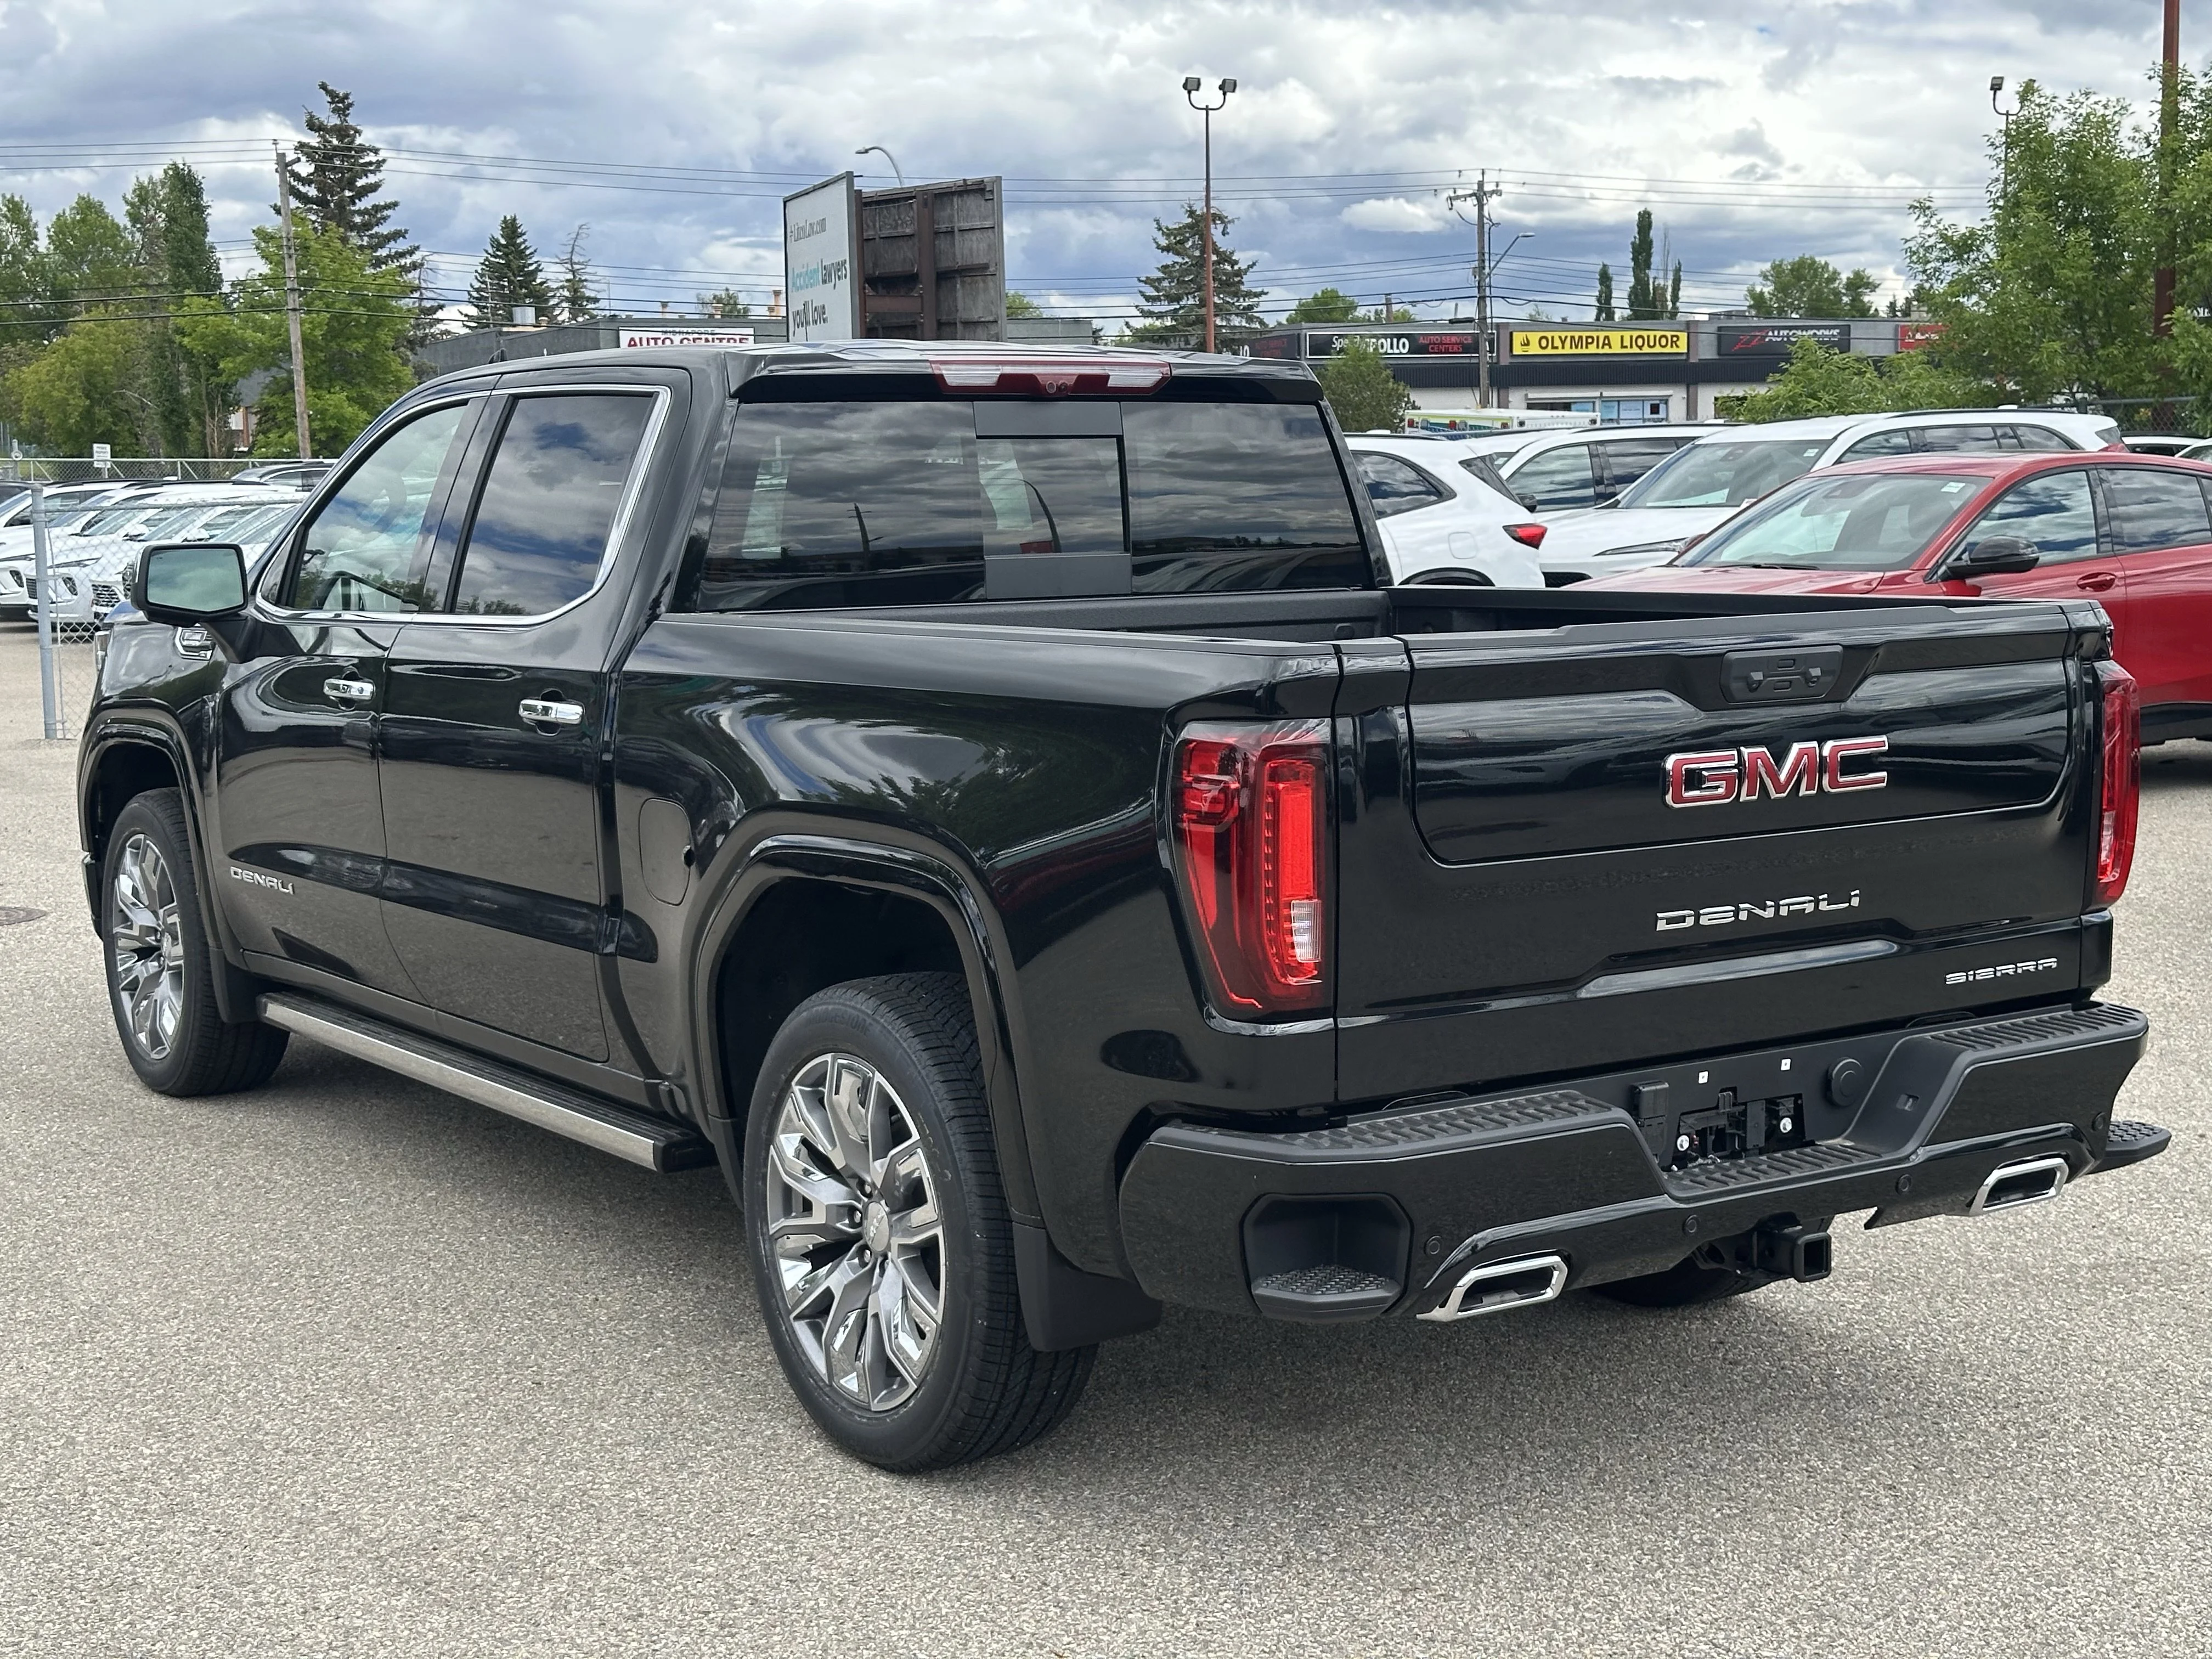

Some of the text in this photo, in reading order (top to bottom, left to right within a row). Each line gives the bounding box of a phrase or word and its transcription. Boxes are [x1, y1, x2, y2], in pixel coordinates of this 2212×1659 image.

[792, 258, 848, 292] Accident lawyers
[1331, 335, 1362, 352] Sped
[1419, 335, 1473, 344] AUTO SERVICE
[1429, 344, 1463, 352] CENTERS
[1538, 334, 1680, 351] OLYMPIA LIQUOR
[1663, 735, 1889, 809] GMC
[230, 866, 295, 895] DENALI
[1656, 889, 1861, 931] DENALI
[1945, 957, 2058, 985] SIERRA
